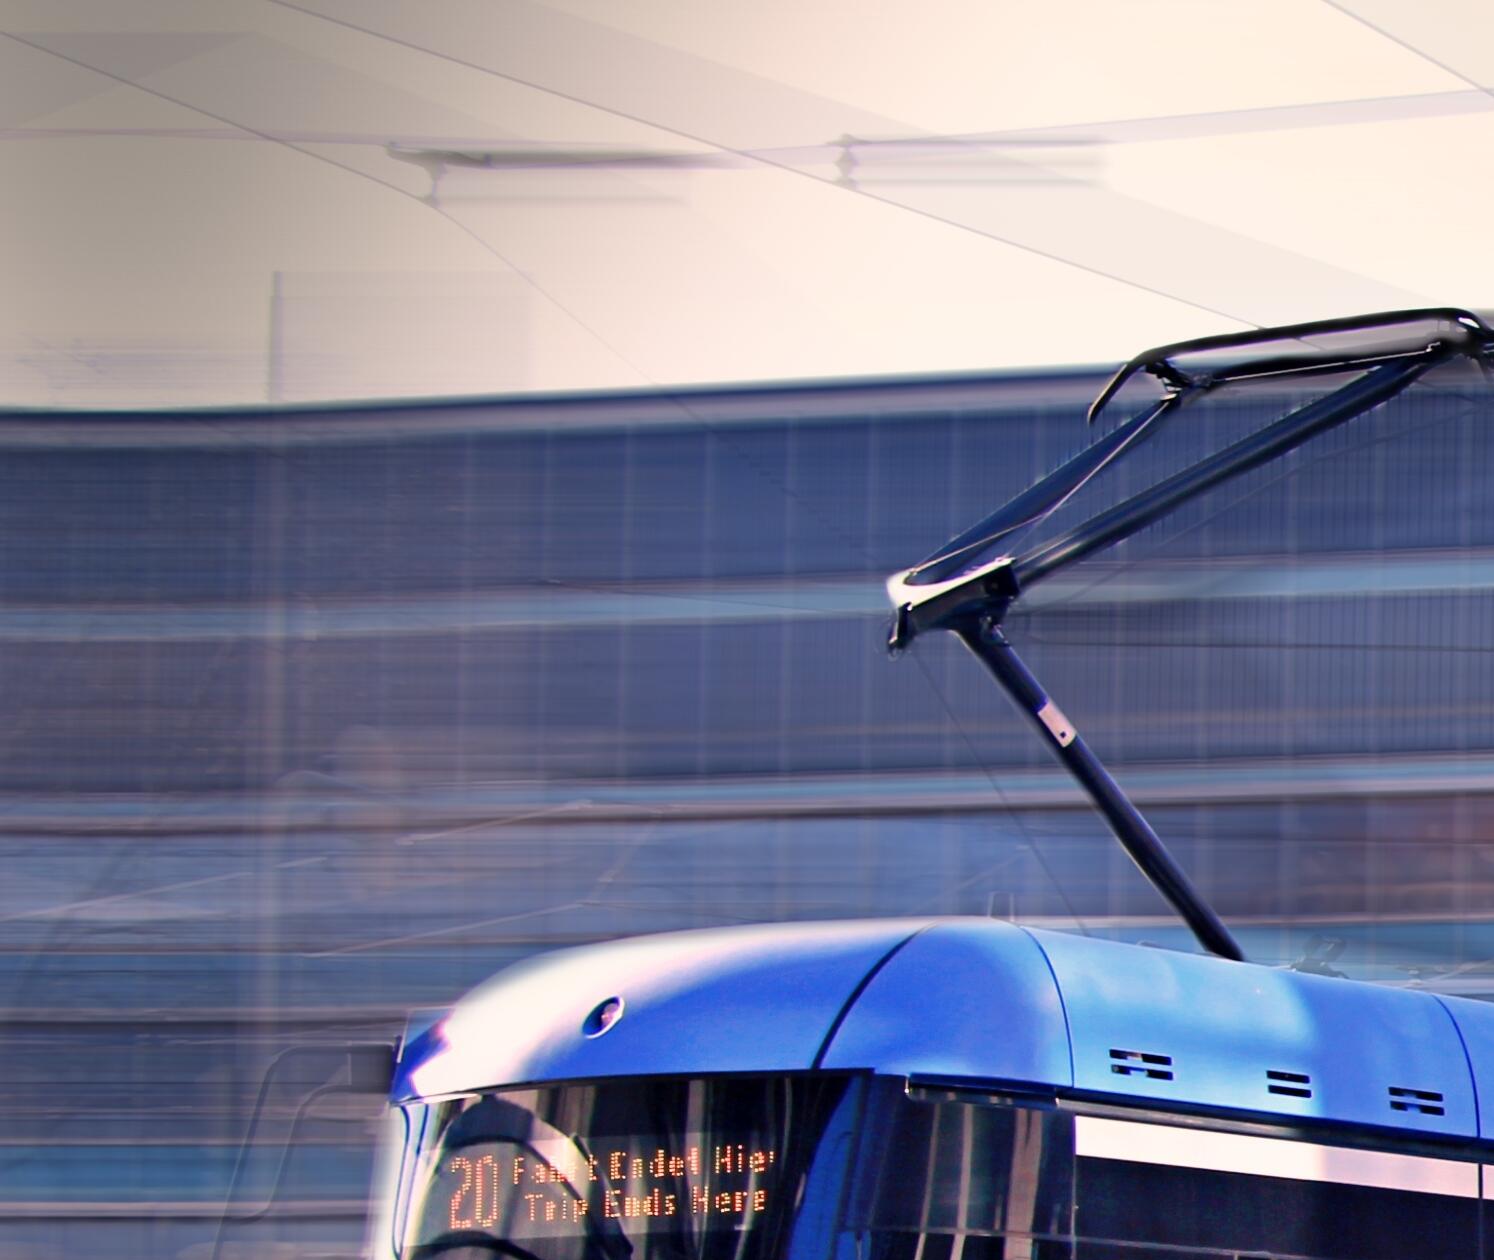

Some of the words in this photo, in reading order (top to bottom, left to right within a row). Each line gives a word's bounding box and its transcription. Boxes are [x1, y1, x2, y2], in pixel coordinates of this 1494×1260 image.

[611, 1147, 698, 1181] Endet
[451, 1155, 498, 1229] 20
[525, 1192, 588, 1223] Trip
[606, 1188, 676, 1218] Ends
[692, 1186, 766, 1214] Here
